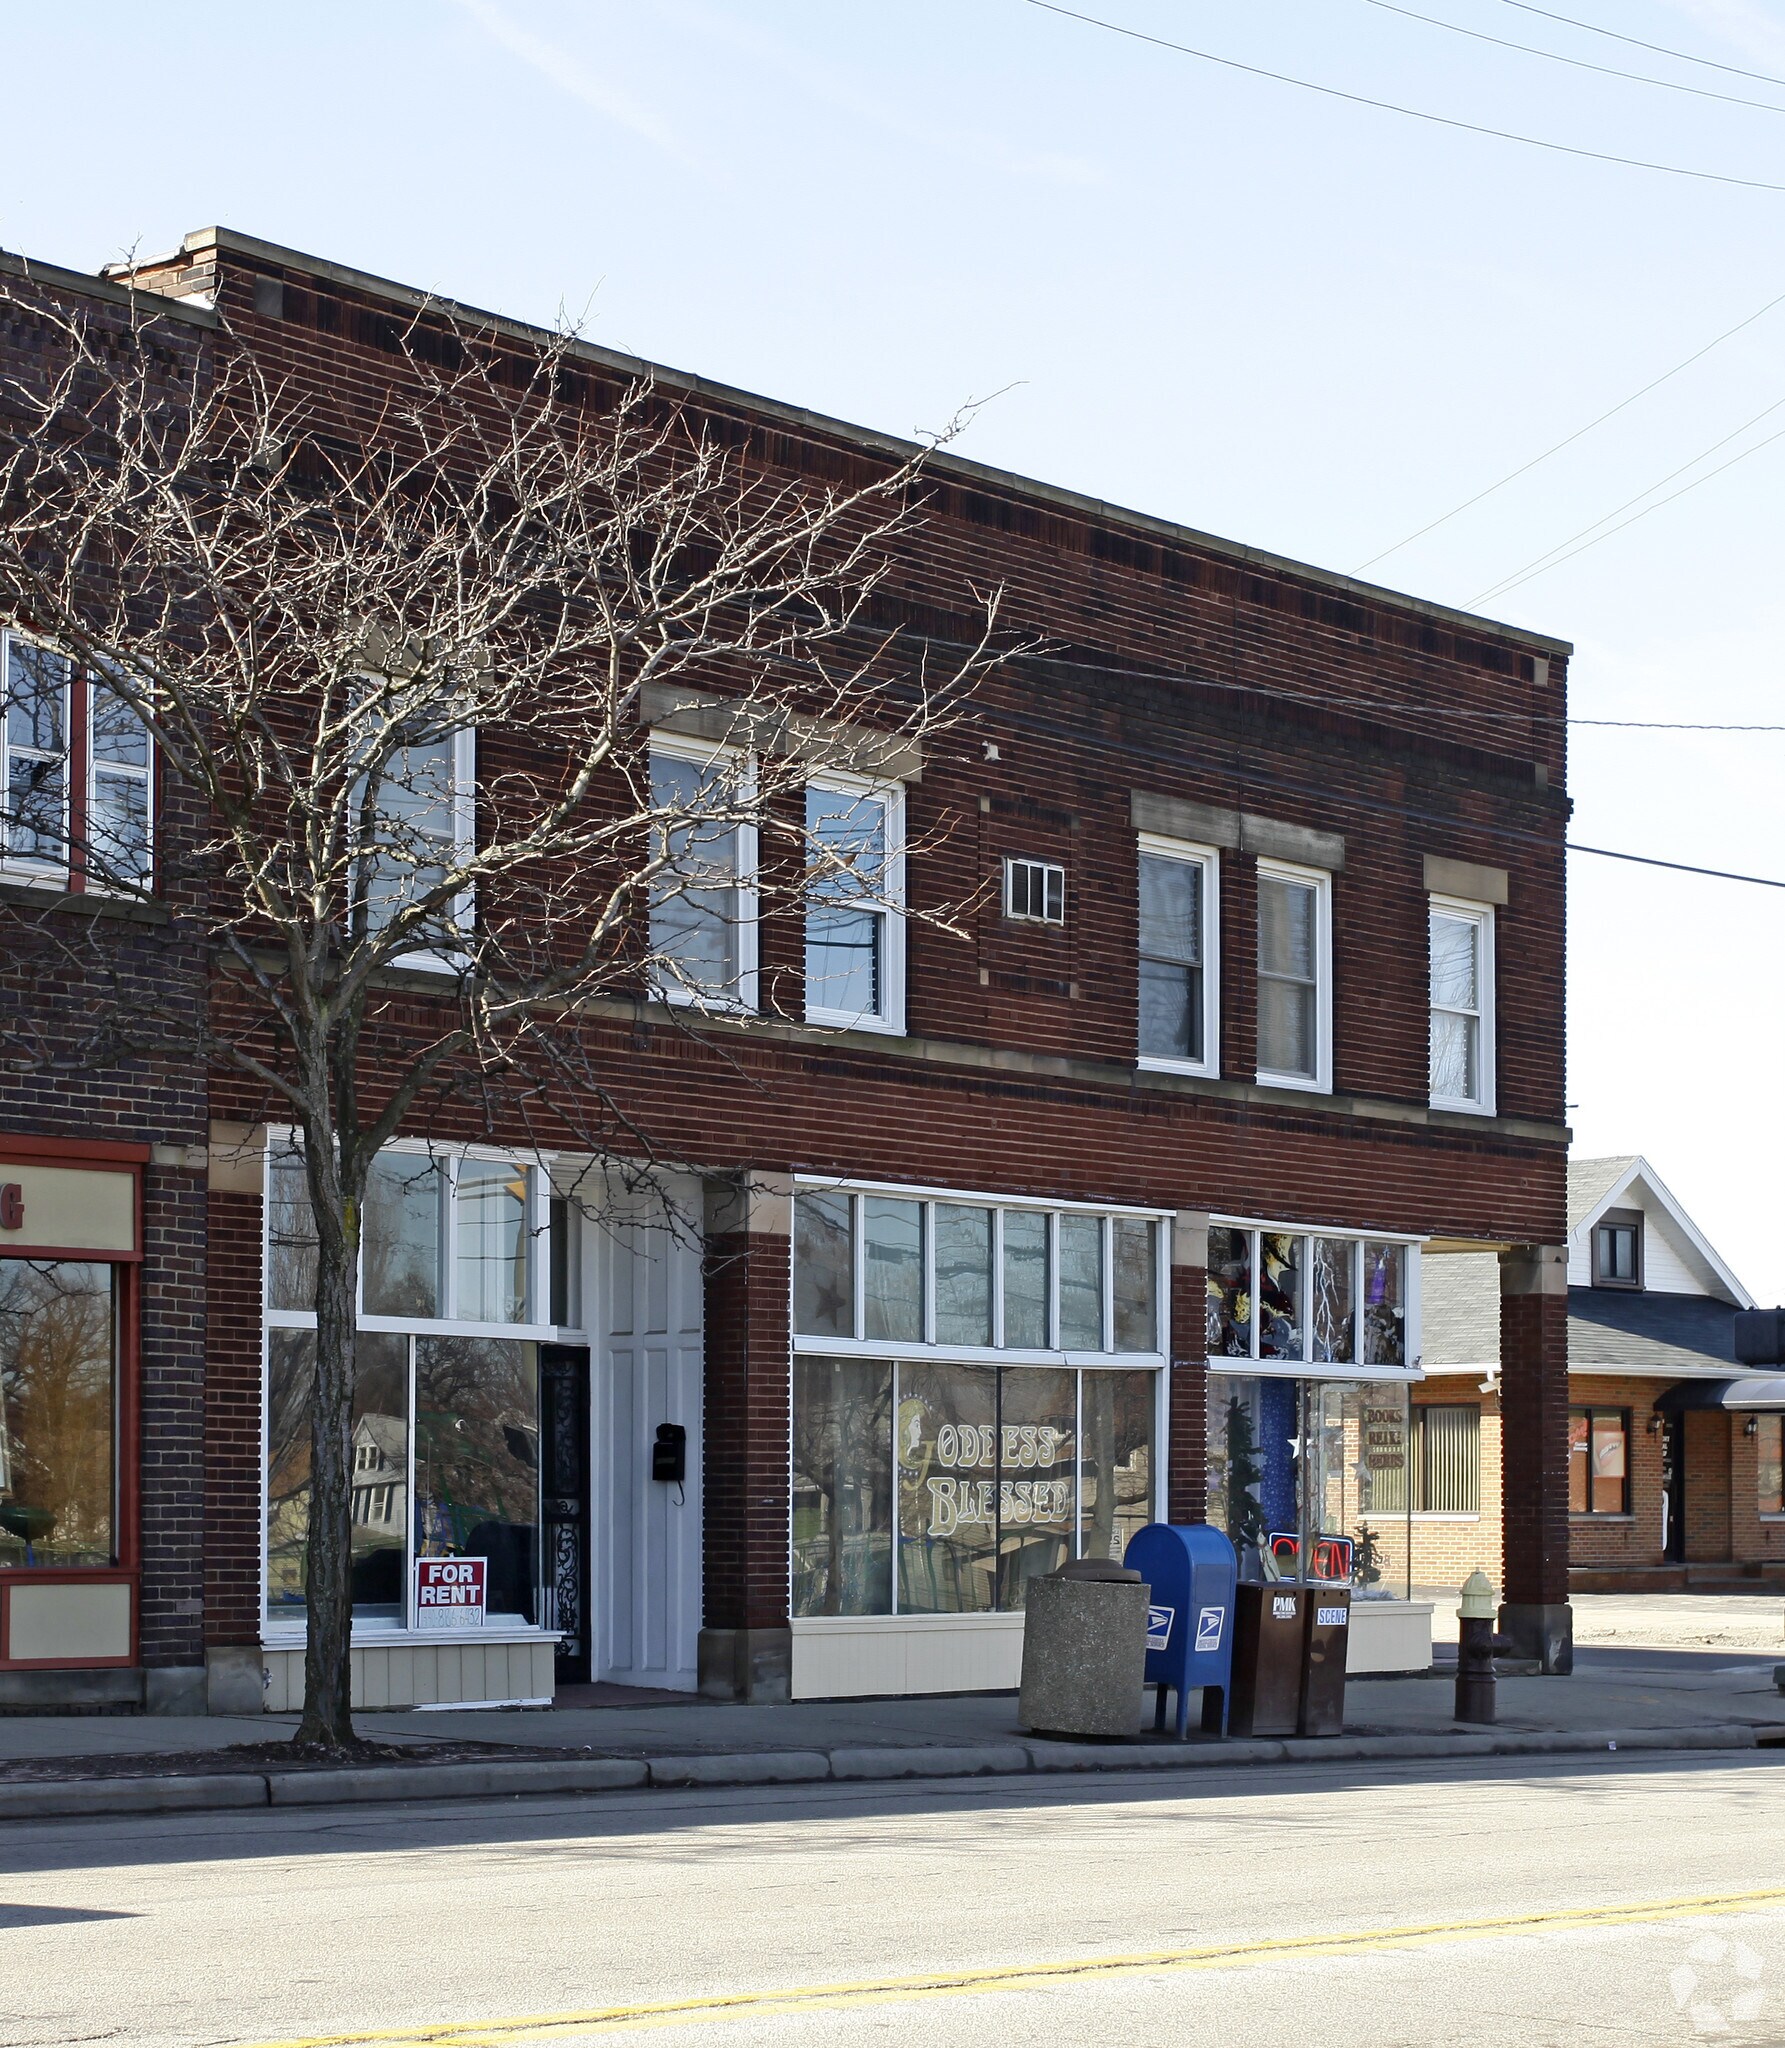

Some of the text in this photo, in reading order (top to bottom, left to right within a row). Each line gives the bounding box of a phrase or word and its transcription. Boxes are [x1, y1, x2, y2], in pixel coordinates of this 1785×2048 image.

[1367, 1408, 1402, 1424] BOOKS
[1273, 1537, 1349, 1579] OEN
[428, 1564, 474, 1584] FOR
[421, 1585, 480, 1604] RENT
[1272, 1596, 1297, 1612] PMK
[1319, 1609, 1346, 1623] SCENE
